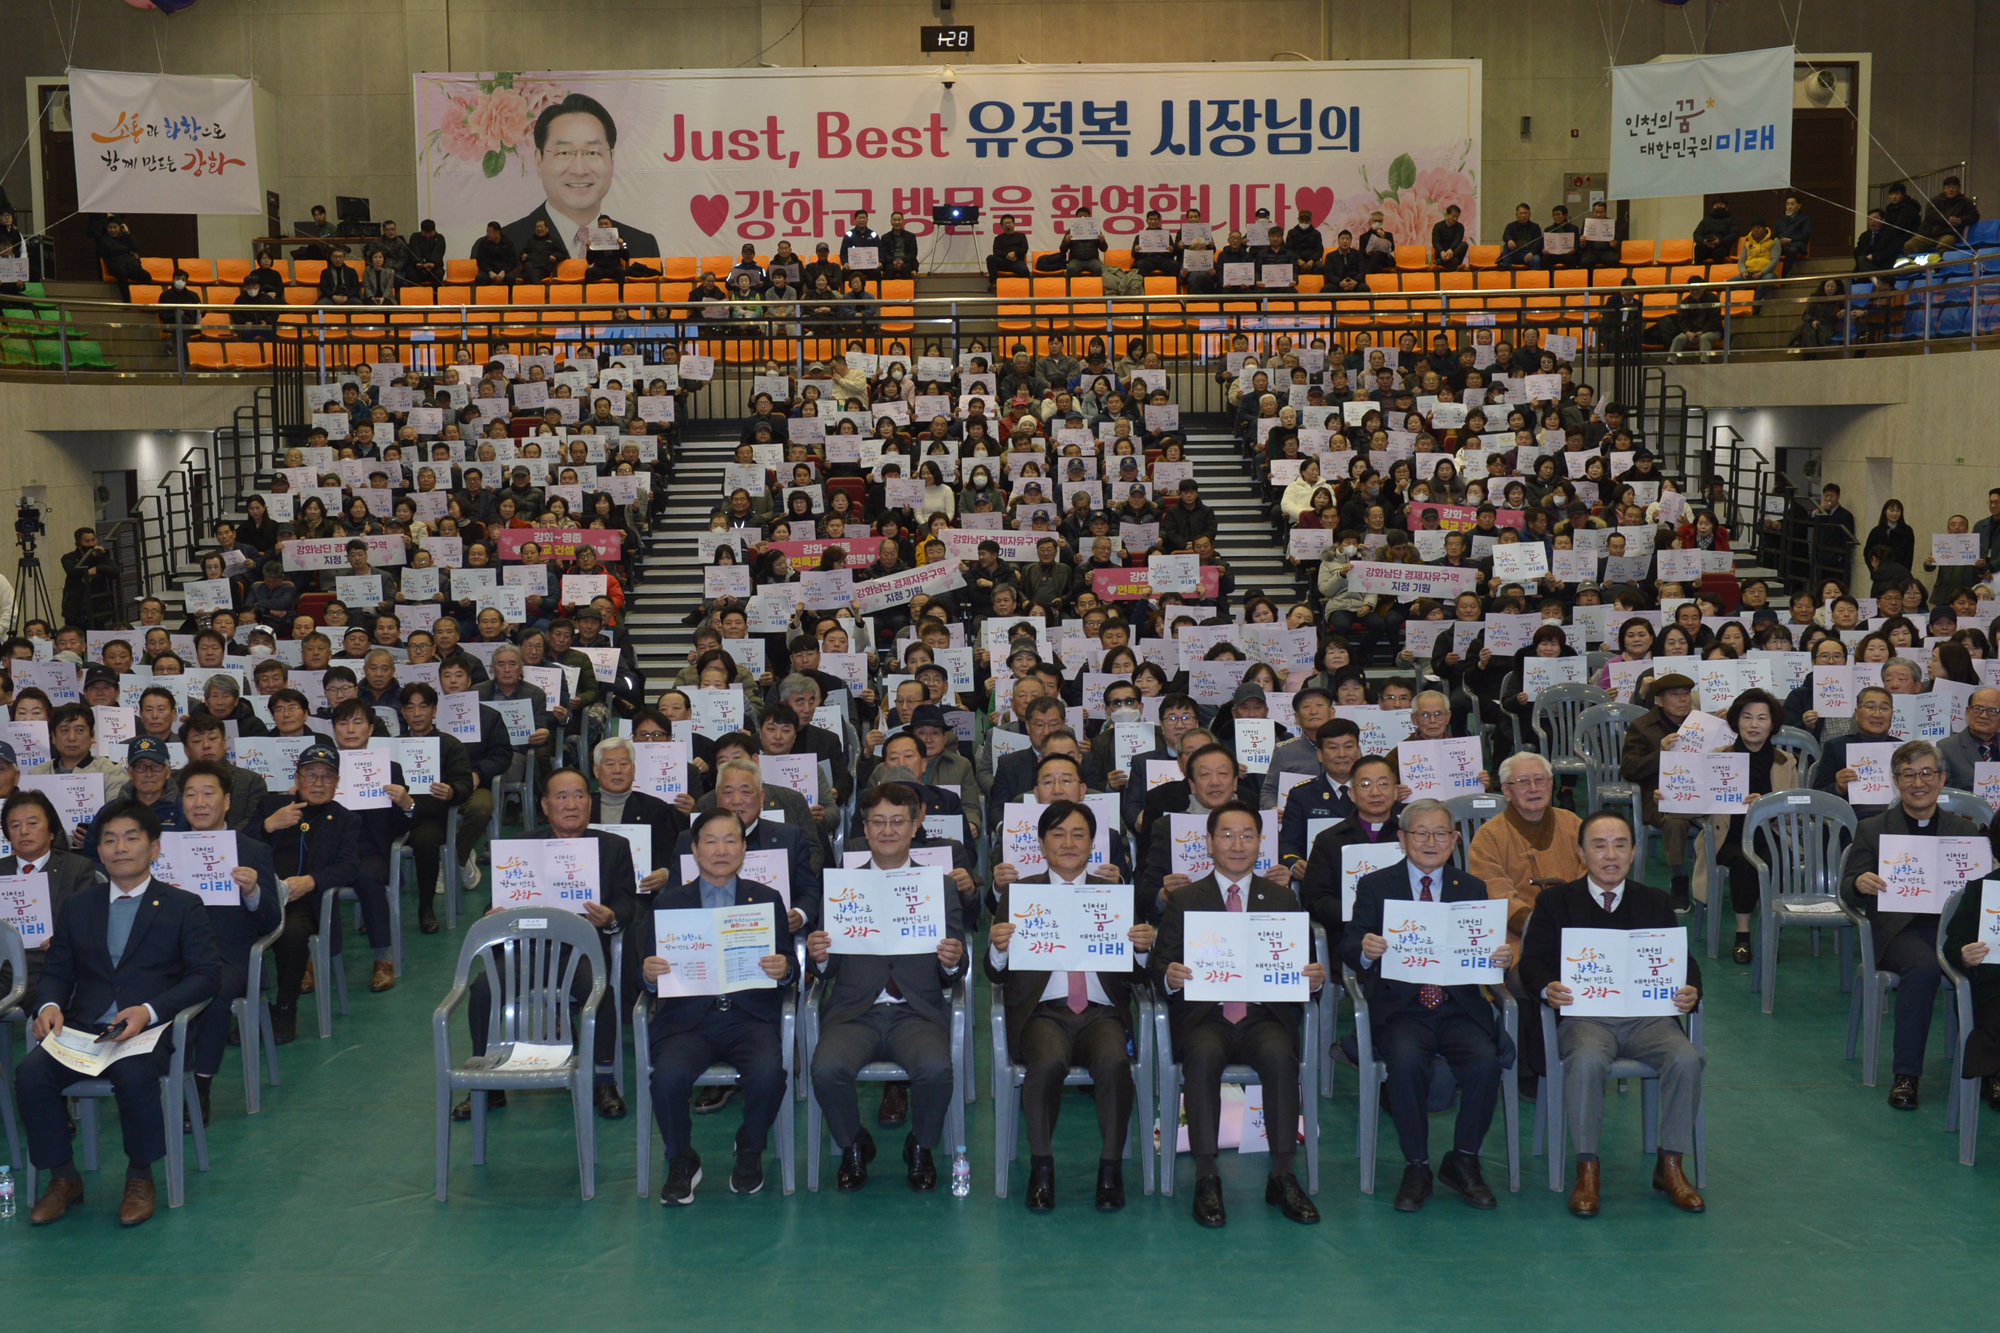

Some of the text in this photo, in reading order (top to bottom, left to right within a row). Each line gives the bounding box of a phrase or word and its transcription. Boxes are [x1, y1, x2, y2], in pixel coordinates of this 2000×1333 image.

[1626, 99, 1705, 137] 인천의 꿈
[91, 111, 225, 144] 소통과 화합으로
[663, 98, 1360, 168] Just, Best 유정복 시장님의
[1640, 124, 1774, 159] 대한민국의 미래
[101, 149, 246, 177] 함께 만드는 강화
[534, 532, 582, 543] 강화~영종
[297, 544, 331, 555] 강화남단
[555, 545, 574, 555] 건설
[999, 548, 1015, 557] 기원
[324, 555, 341, 565] 지정
[792, 554, 866, 567] 연륙교 염원
[1366, 567, 1459, 583] 강화남단 경제자유구역
[856, 567, 946, 598] 강화남단 경제자유구역
[1391, 582, 1430, 593] 지정 기원
[885, 586, 923, 603] 지정 기원
[1297, 656, 1314, 664] 미래
[453, 724, 475, 734] 미래
[717, 724, 739, 732] 미래
[1922, 727, 1945, 736] 미래
[1247, 755, 1270, 764] 미래
[1449, 750, 1466, 758] 인천의
[1457, 758, 1470, 771] 꿈
[1712, 765, 1731, 773] 인천의
[411, 775, 434, 783] 미래
[1454, 778, 1479, 787] 미래
[1720, 772, 1735, 785] 꿈
[1415, 780, 1441, 790] 강화
[360, 788, 385, 797] 미래
[1673, 792, 1700, 801] 강화
[1716, 794, 1742, 803] 미래
[192, 847, 214, 856] 인천의
[1946, 853, 1968, 861] 인천의
[203, 855, 220, 871] 꿈
[554, 854, 576, 862] 인천의
[564, 863, 582, 879] 꿈
[1956, 862, 1974, 878] 꿈
[500, 879, 517, 888] 함께
[1888, 875, 1906, 883] 함께
[200, 880, 232, 891] 미래
[894, 885, 918, 896] 인천의
[1896, 885, 1931, 897] 강화
[1, 891, 24, 900] 인천의
[509, 889, 542, 900] 강화
[561, 889, 592, 900] 미래
[14, 899, 32, 915] 꿈
[905, 896, 925, 914] 꿈
[1082, 903, 1107, 912] 인천의
[833, 914, 854, 924] 함께
[892, 915, 930, 924] 대한민국의
[1094, 913, 1114, 932] 꿈
[1457, 918, 1482, 928] 인천의
[842, 925, 880, 938] 강화
[901, 924, 937, 938] 미래
[1018, 930, 1038, 940] 함께
[1257, 931, 1282, 940] 인천의
[1468, 929, 1488, 946] 꿈
[691, 942, 712, 950] 강화
[1029, 942, 1066, 953] 강화
[1088, 942, 1124, 955] 미래
[1269, 941, 1289, 961] 꿈
[1392, 945, 1412, 954] 함께
[1454, 947, 1491, 955] 대한민국의
[1637, 946, 1662, 958] 인천의
[1194, 958, 1214, 968] 함께
[1256, 961, 1293, 969] 대한민국의
[1401, 955, 1440, 968] 강화
[1461, 956, 1496, 968] 미래
[1648, 957, 1668, 976] 꿈
[1204, 970, 1242, 983] 강화
[1264, 971, 1300, 986] 미래
[1571, 973, 1591, 984] 함께
[1634, 977, 1672, 985] 대한민국의
[1581, 986, 1620, 999] 강화
[1642, 986, 1678, 1000] 미래
